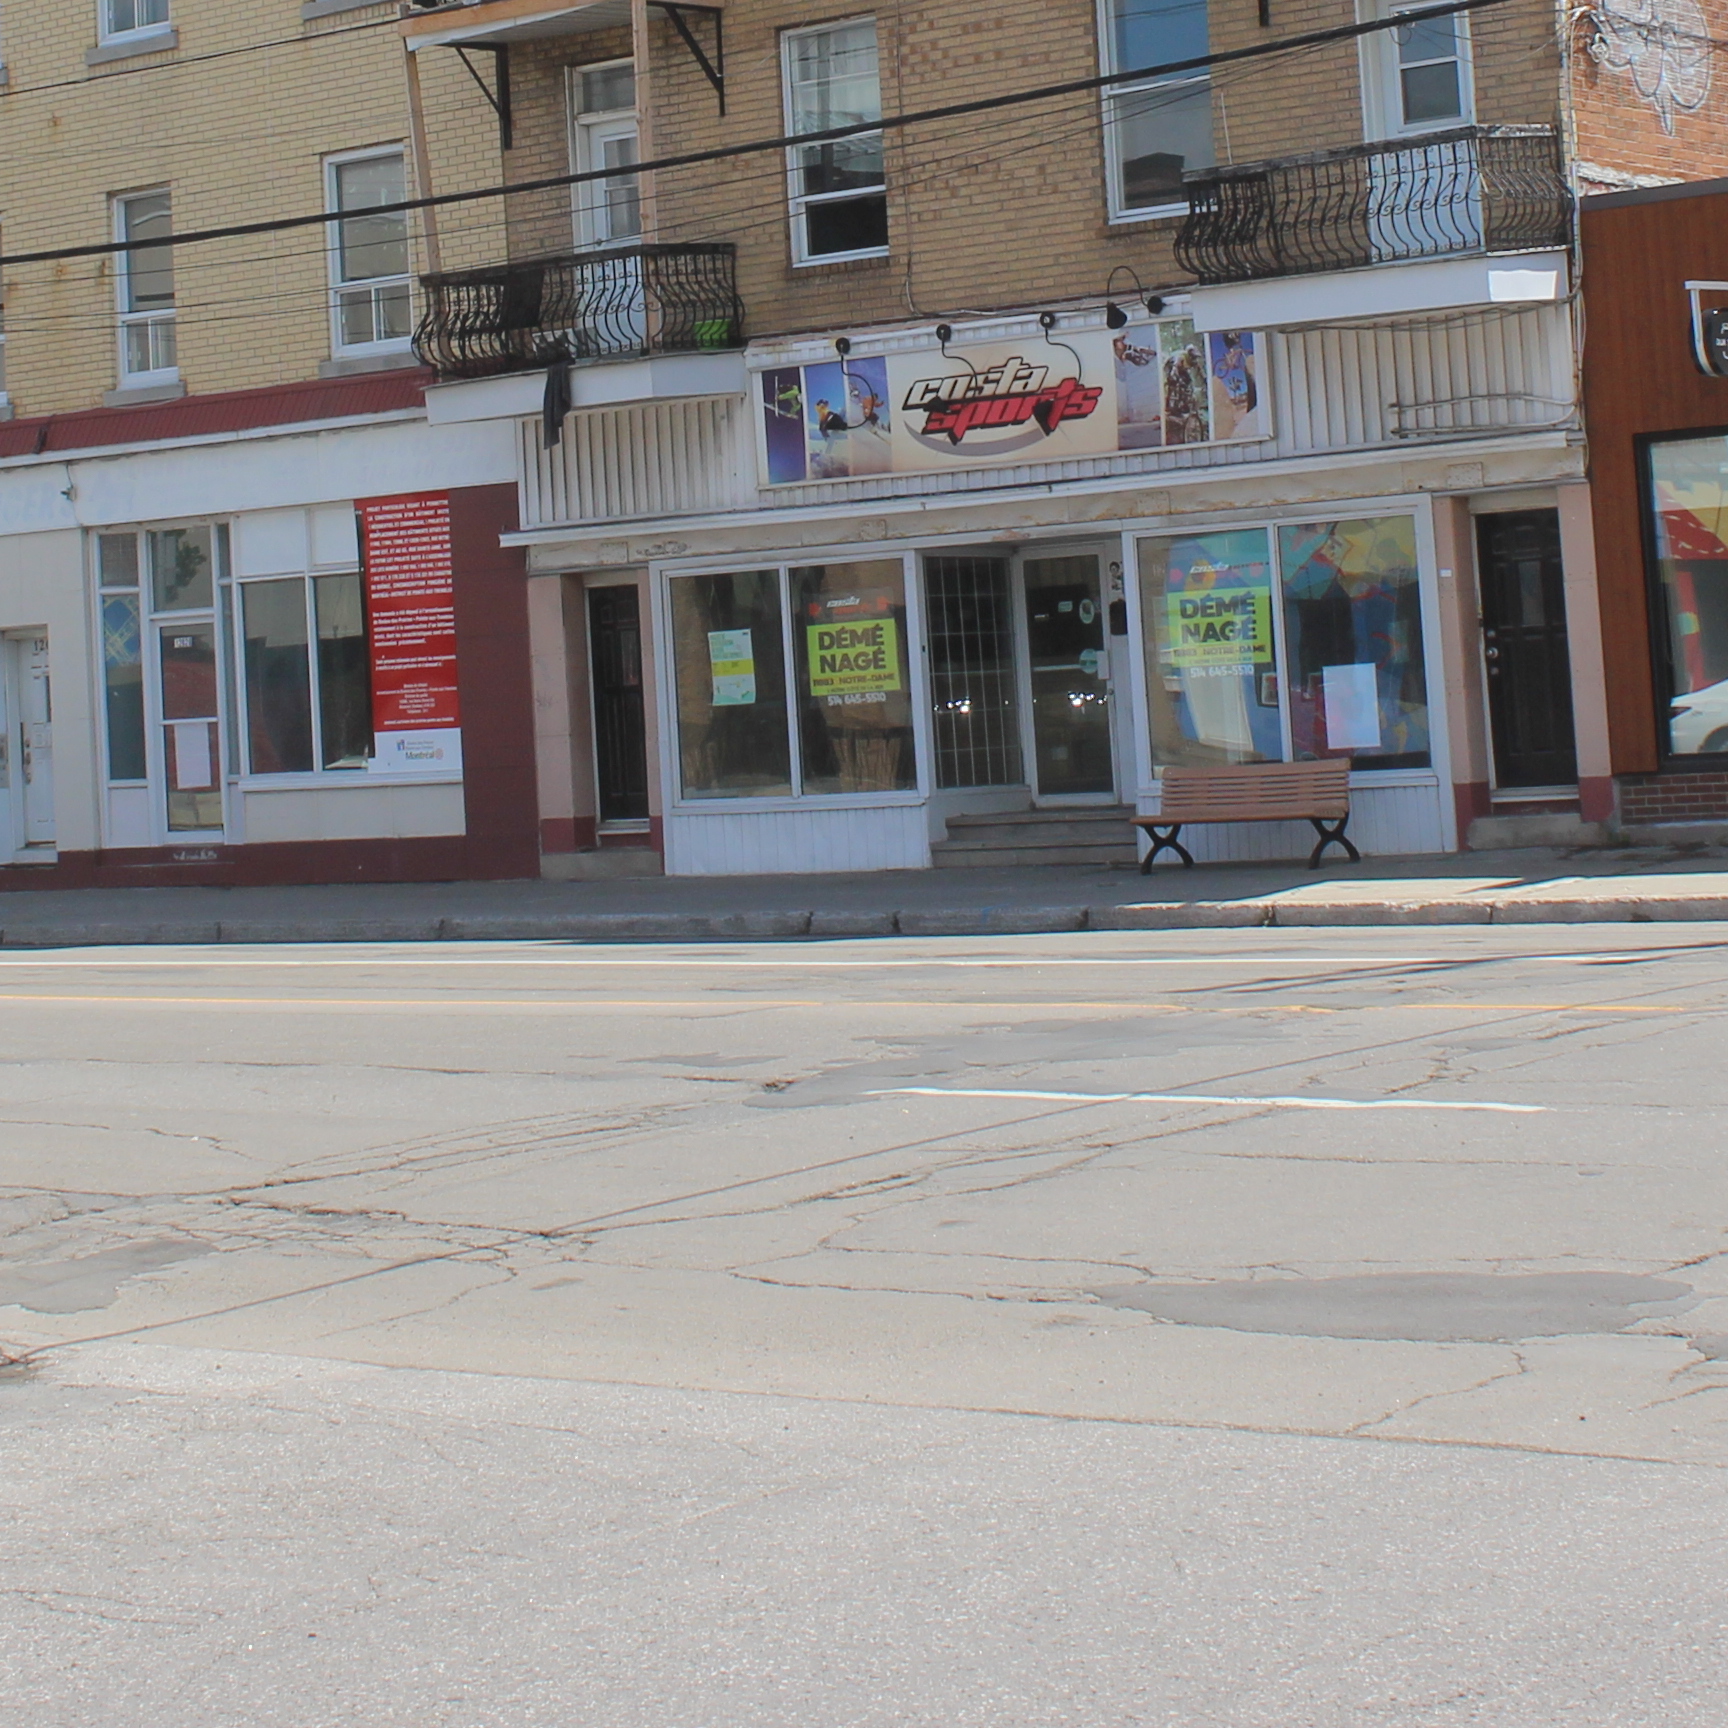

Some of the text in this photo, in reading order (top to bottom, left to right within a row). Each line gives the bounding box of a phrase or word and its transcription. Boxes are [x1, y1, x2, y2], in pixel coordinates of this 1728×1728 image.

[902, 357, 1049, 411] costa
[921, 377, 1103, 446] sports
[1179, 591, 1257, 619] DÉMÉ
[817, 622, 885, 651] DÉMÉ
[1181, 615, 1258, 644] NAGÉ
[819, 646, 887, 674] NAGÉ
